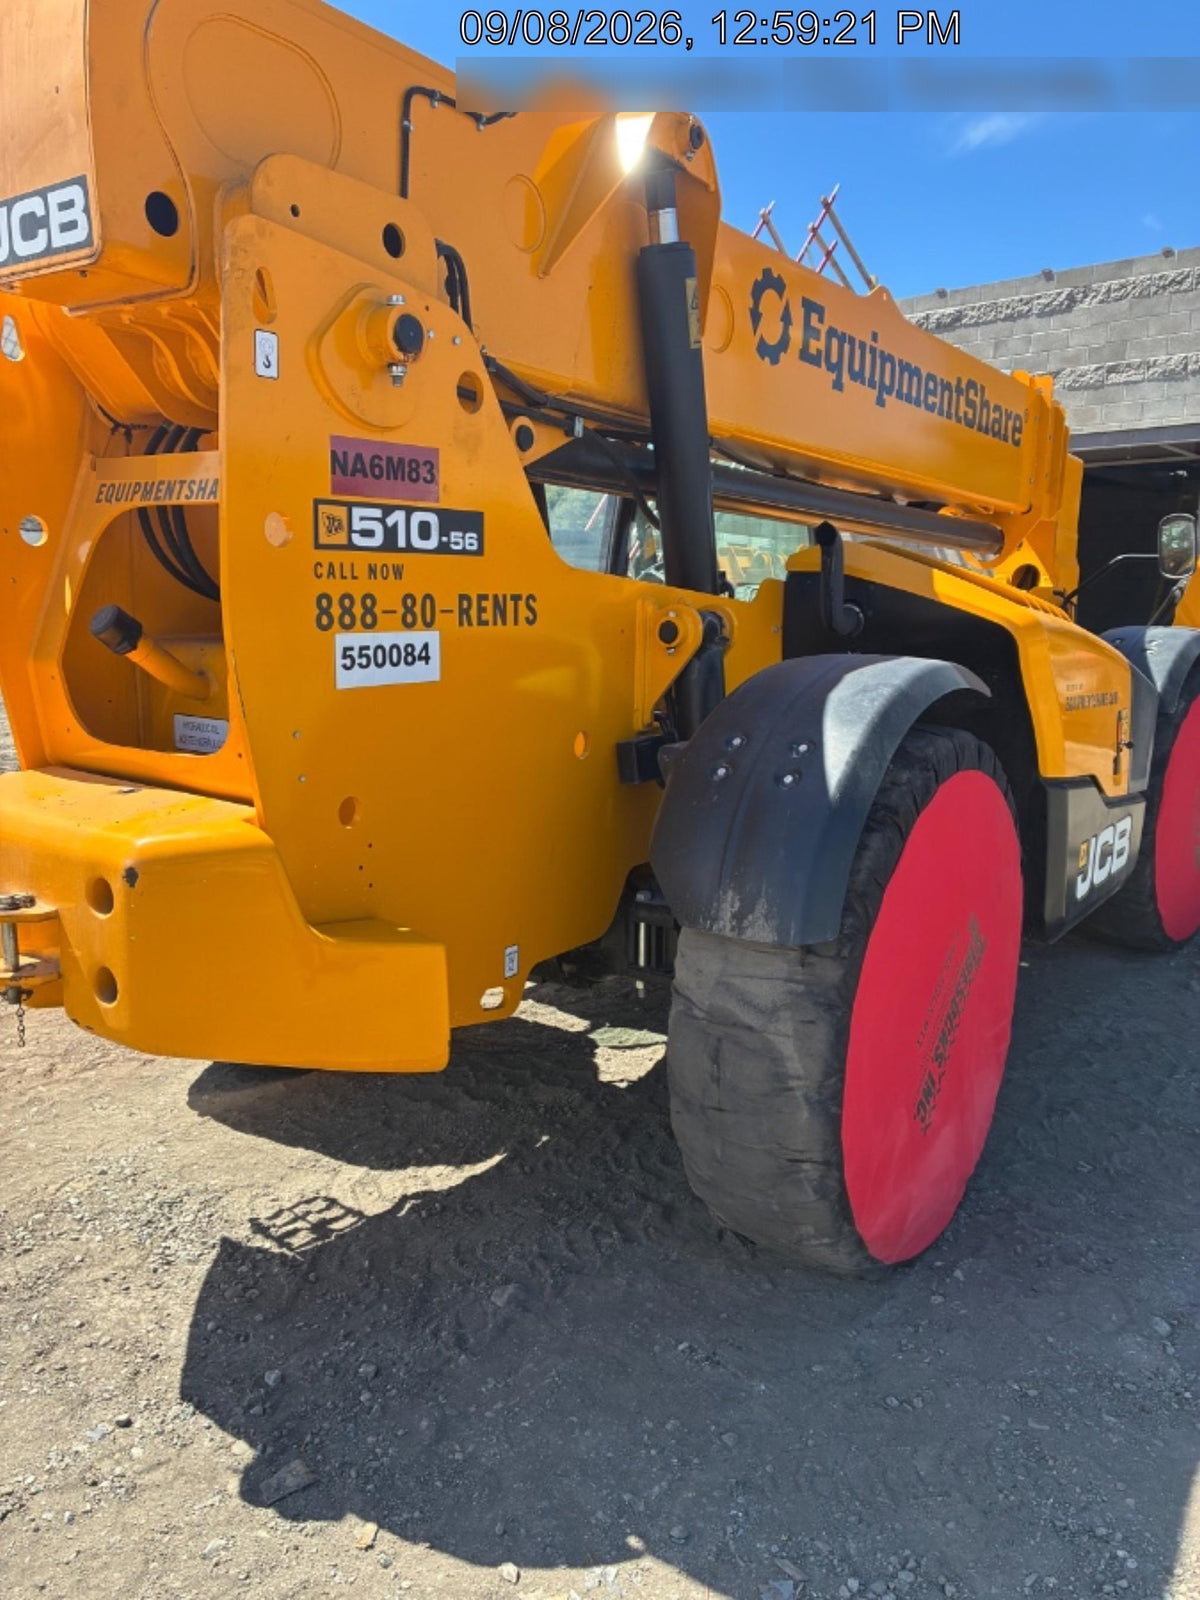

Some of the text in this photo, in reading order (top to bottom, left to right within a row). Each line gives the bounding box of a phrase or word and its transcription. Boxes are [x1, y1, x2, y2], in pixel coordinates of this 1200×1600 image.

[798, 296, 1023, 447] EquipmentShare
[331, 449, 436, 484] NA6M83
[351, 506, 479, 551] 510-56
[313, 561, 405, 580] CALL NOW
[315, 592, 538, 631] 888-80-RENTS
[341, 642, 431, 671] 550084
[1076, 815, 1132, 899] JCB
